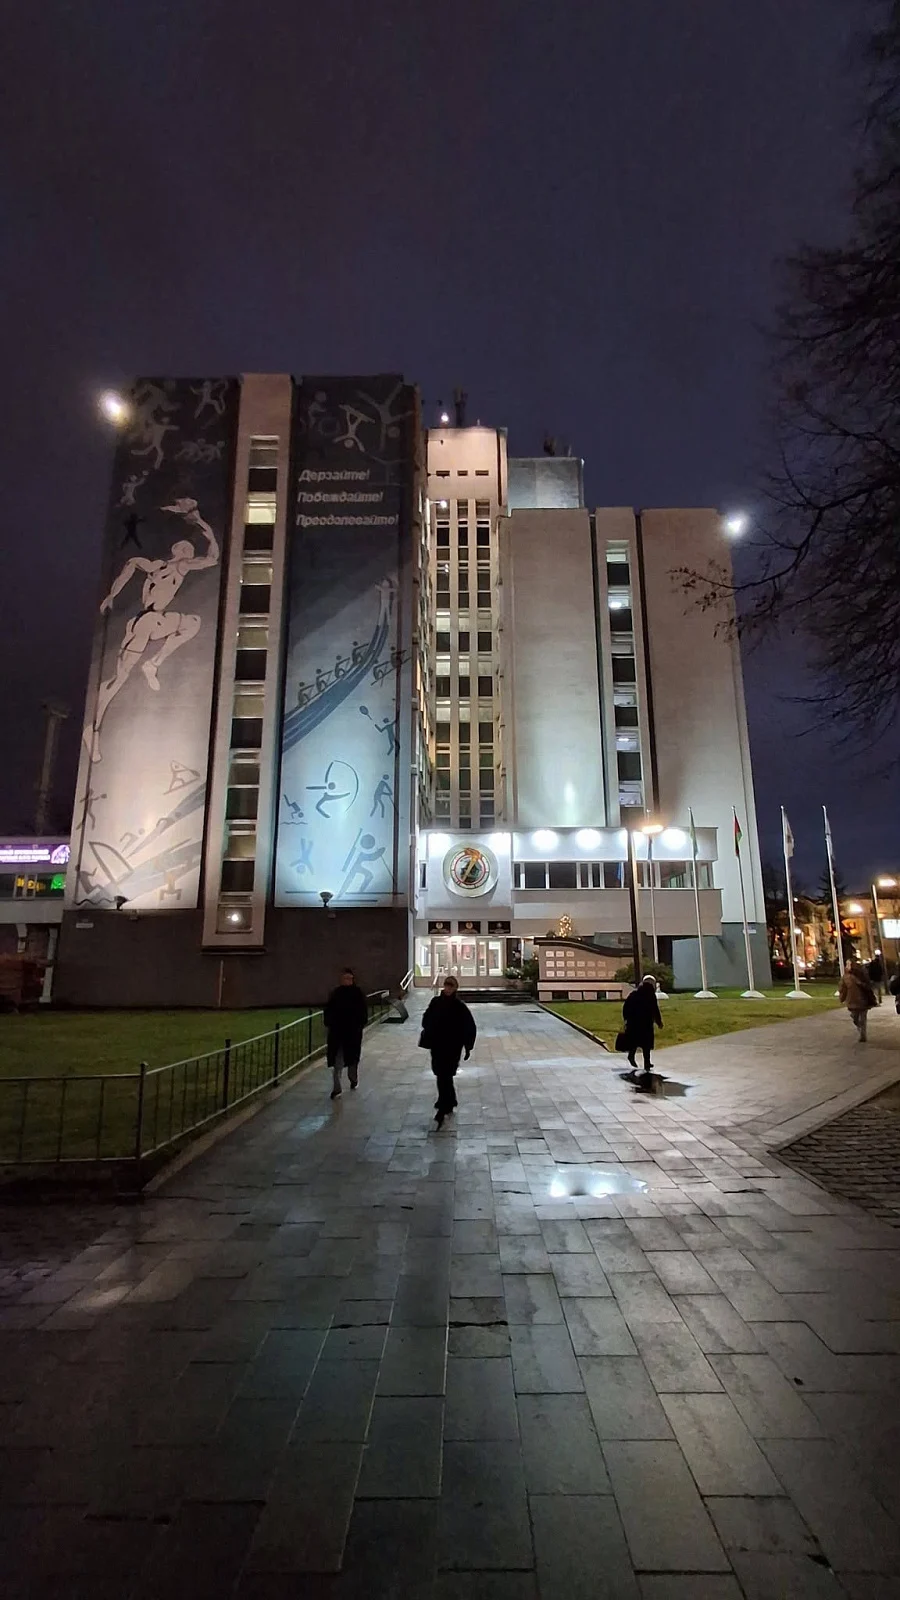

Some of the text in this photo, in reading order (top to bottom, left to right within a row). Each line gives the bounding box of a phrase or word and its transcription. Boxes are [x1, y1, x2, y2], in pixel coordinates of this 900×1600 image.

[298, 469, 370, 482] Дерзайте!
[297, 491, 384, 503] Побеждайте!
[296, 514, 399, 527] Преодолевайте!
